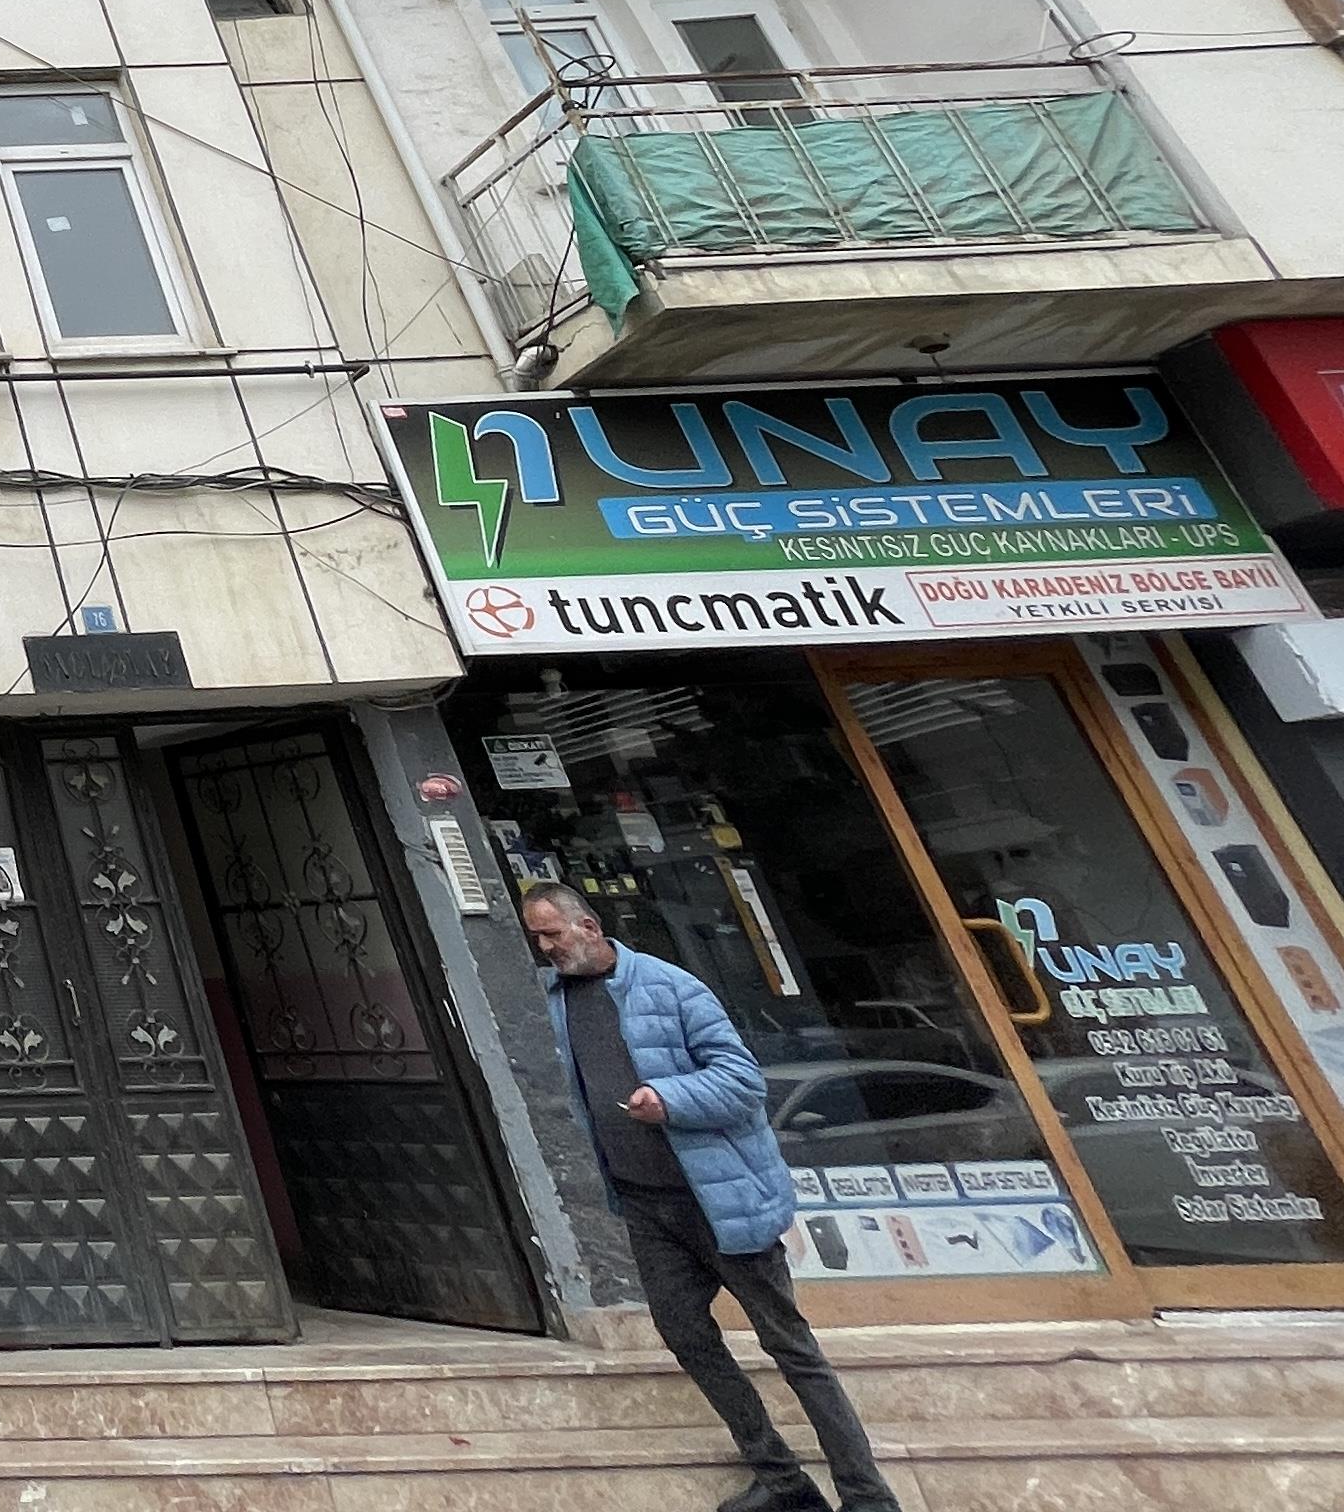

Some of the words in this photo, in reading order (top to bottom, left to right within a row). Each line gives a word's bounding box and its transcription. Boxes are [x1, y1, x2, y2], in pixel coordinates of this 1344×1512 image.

[625, 497, 774, 539] GÜÇ
[930, 528, 991, 563] GÜÇ
[992, 524, 1166, 556] KAYNAKLARI
[1188, 523, 1241, 549] UPS
[918, 573, 989, 604] DOĞU
[994, 570, 1130, 601] KARADENİZ
[1131, 566, 1213, 595] BÖLGE
[548, 575, 906, 636] tuncmatik
[1007, 597, 1109, 620] YETKİLİ
[1123, 594, 1225, 614] SERVİSİ
